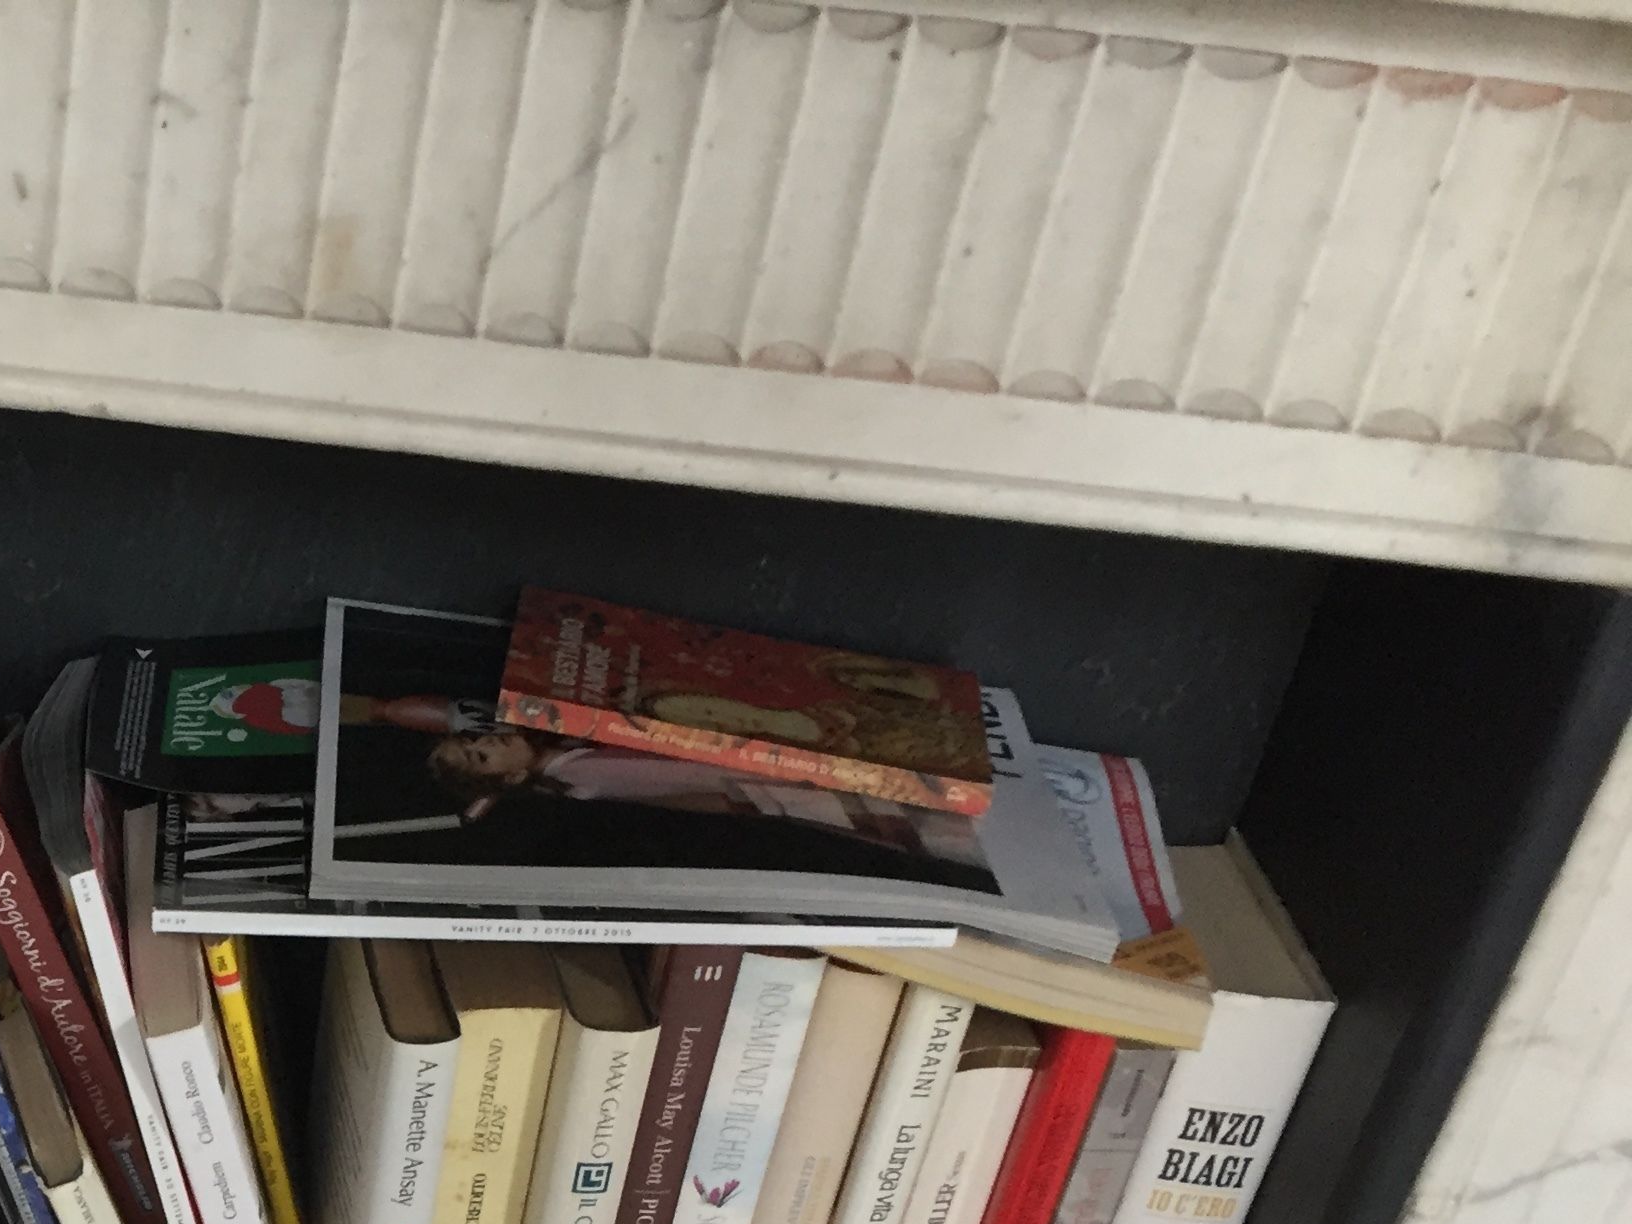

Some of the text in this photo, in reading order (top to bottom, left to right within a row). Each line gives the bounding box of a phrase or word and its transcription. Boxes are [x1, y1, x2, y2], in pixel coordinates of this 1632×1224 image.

[170, 672, 227, 751] Natale
[451, 925, 633, 938] VANITY FAIR OTTOBRE 2015
[667, 1024, 703, 1089] Louisa
[710, 980, 795, 1173] ROSAMUNDE PILCHER
[910, 1004, 962, 1099] MARAINI
[406, 1081, 437, 1152] Manette
[591, 1050, 630, 1159] MAX GALLO
[656, 1090, 687, 1128] May
[1176, 1107, 1264, 1148] ENZO
[181, 1061, 237, 1220] Carpediem Claudio Ronco
[888, 1143, 917, 1182] lunga
[390, 1155, 425, 1208] Ansay
[1158, 1148, 1253, 1190] BIAGI
[877, 1186, 899, 1221] vita
[1146, 1188, 1238, 1220] IO C'ERO
